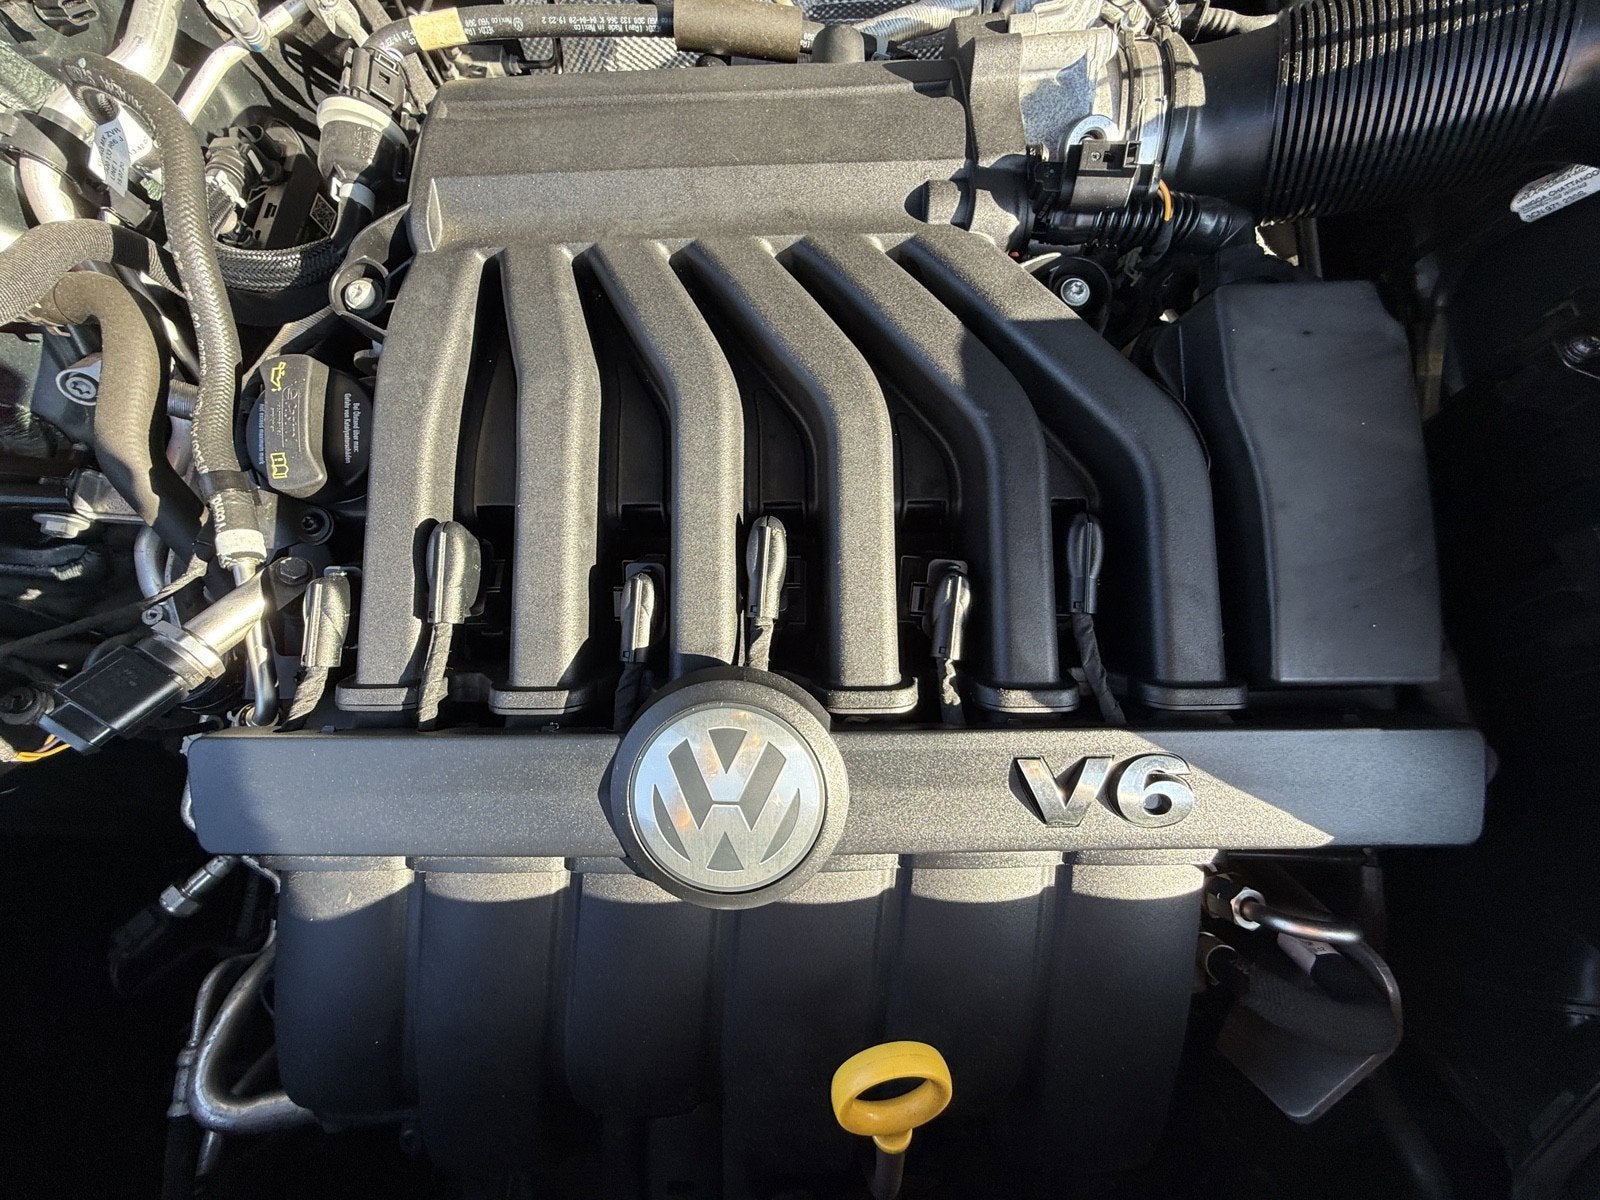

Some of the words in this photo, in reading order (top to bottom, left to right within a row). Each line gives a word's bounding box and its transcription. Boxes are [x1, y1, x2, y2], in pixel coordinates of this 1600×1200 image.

[105, 127, 121, 137] ZVR
[344, 393, 352, 409] Gefahr
[353, 410, 361, 429] Ölstand
[343, 418, 352, 464] Katalysatorschäden
[1013, 754, 1196, 828] V6
